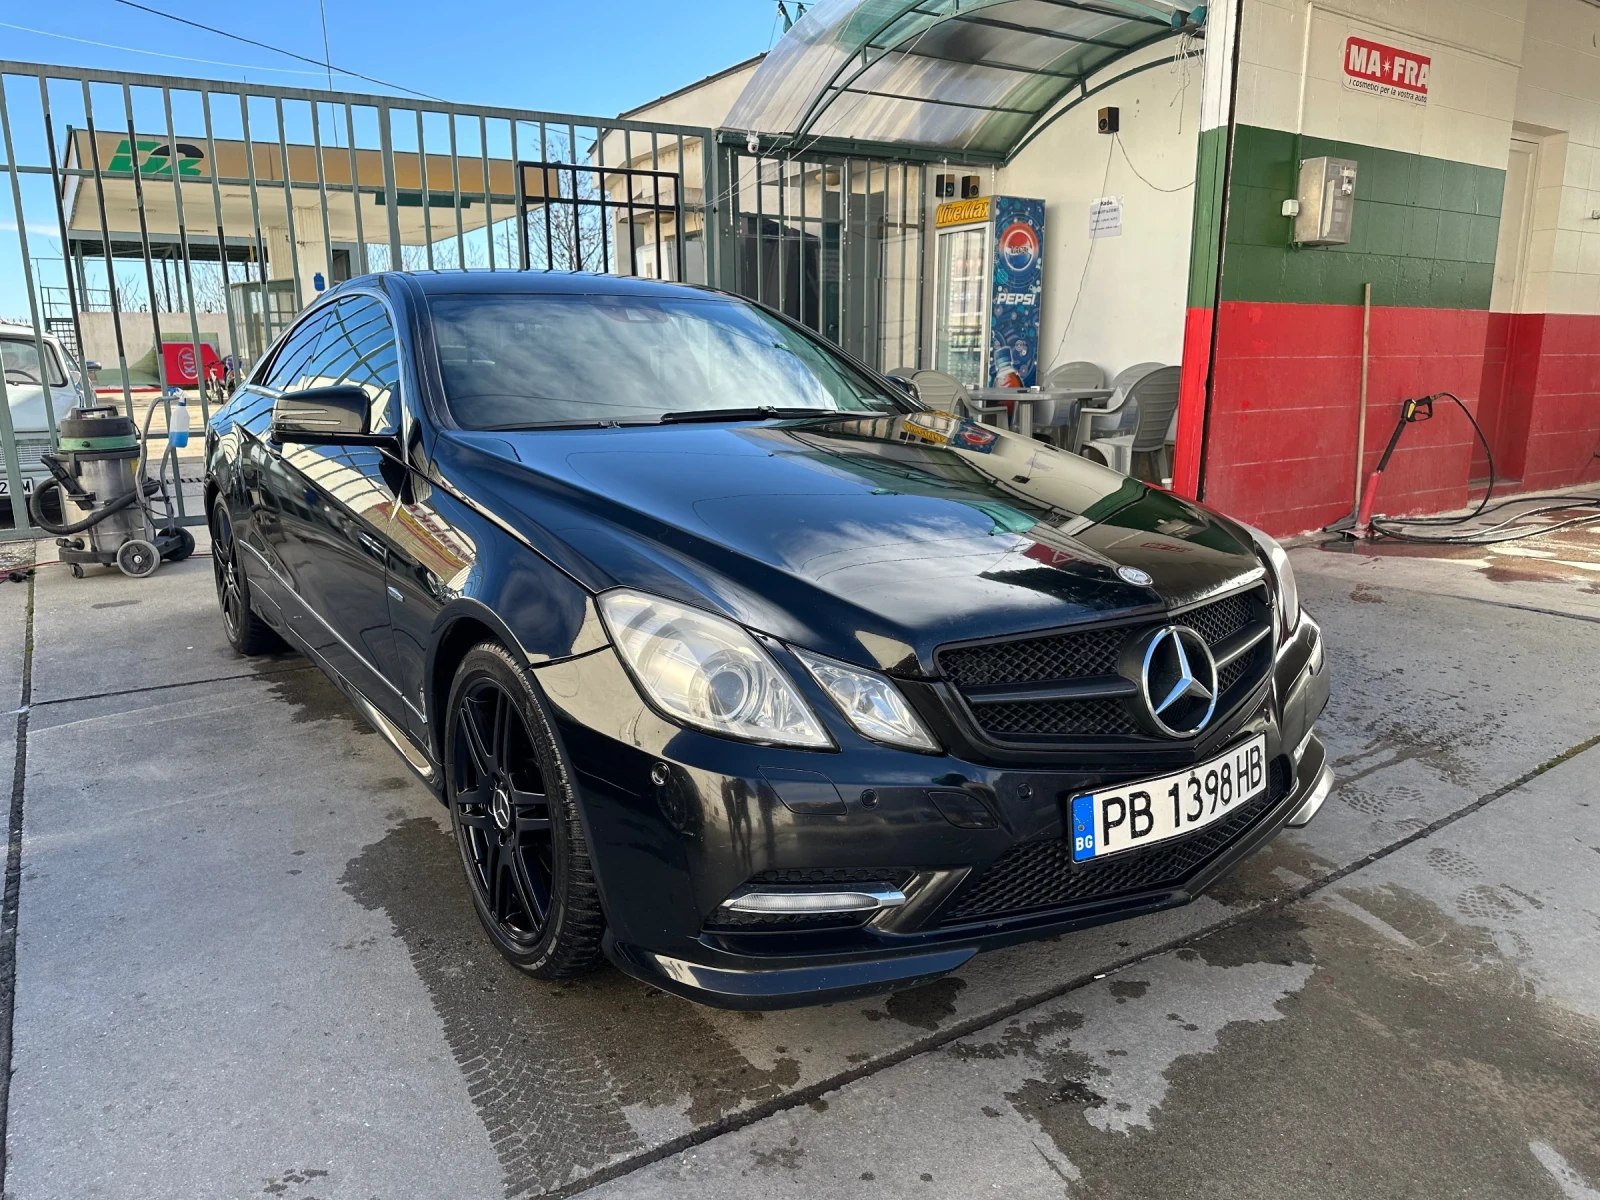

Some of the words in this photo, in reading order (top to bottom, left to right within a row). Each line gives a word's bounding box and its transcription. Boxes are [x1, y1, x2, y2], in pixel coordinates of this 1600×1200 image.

[1352, 79, 1379, 92] cosmetici
[1379, 85, 1390, 95] per
[1390, 87, 1396, 96] la
[1397, 90, 1414, 100] vostra
[1414, 93, 1427, 103] auto
[996, 292, 1036, 306] PEPSI
[182, 352, 196, 374] KIA
[1102, 790, 1154, 847] PB
[1167, 761, 1233, 828] 1398
[1236, 745, 1263, 799] HB
[1075, 835, 1093, 851] BG
